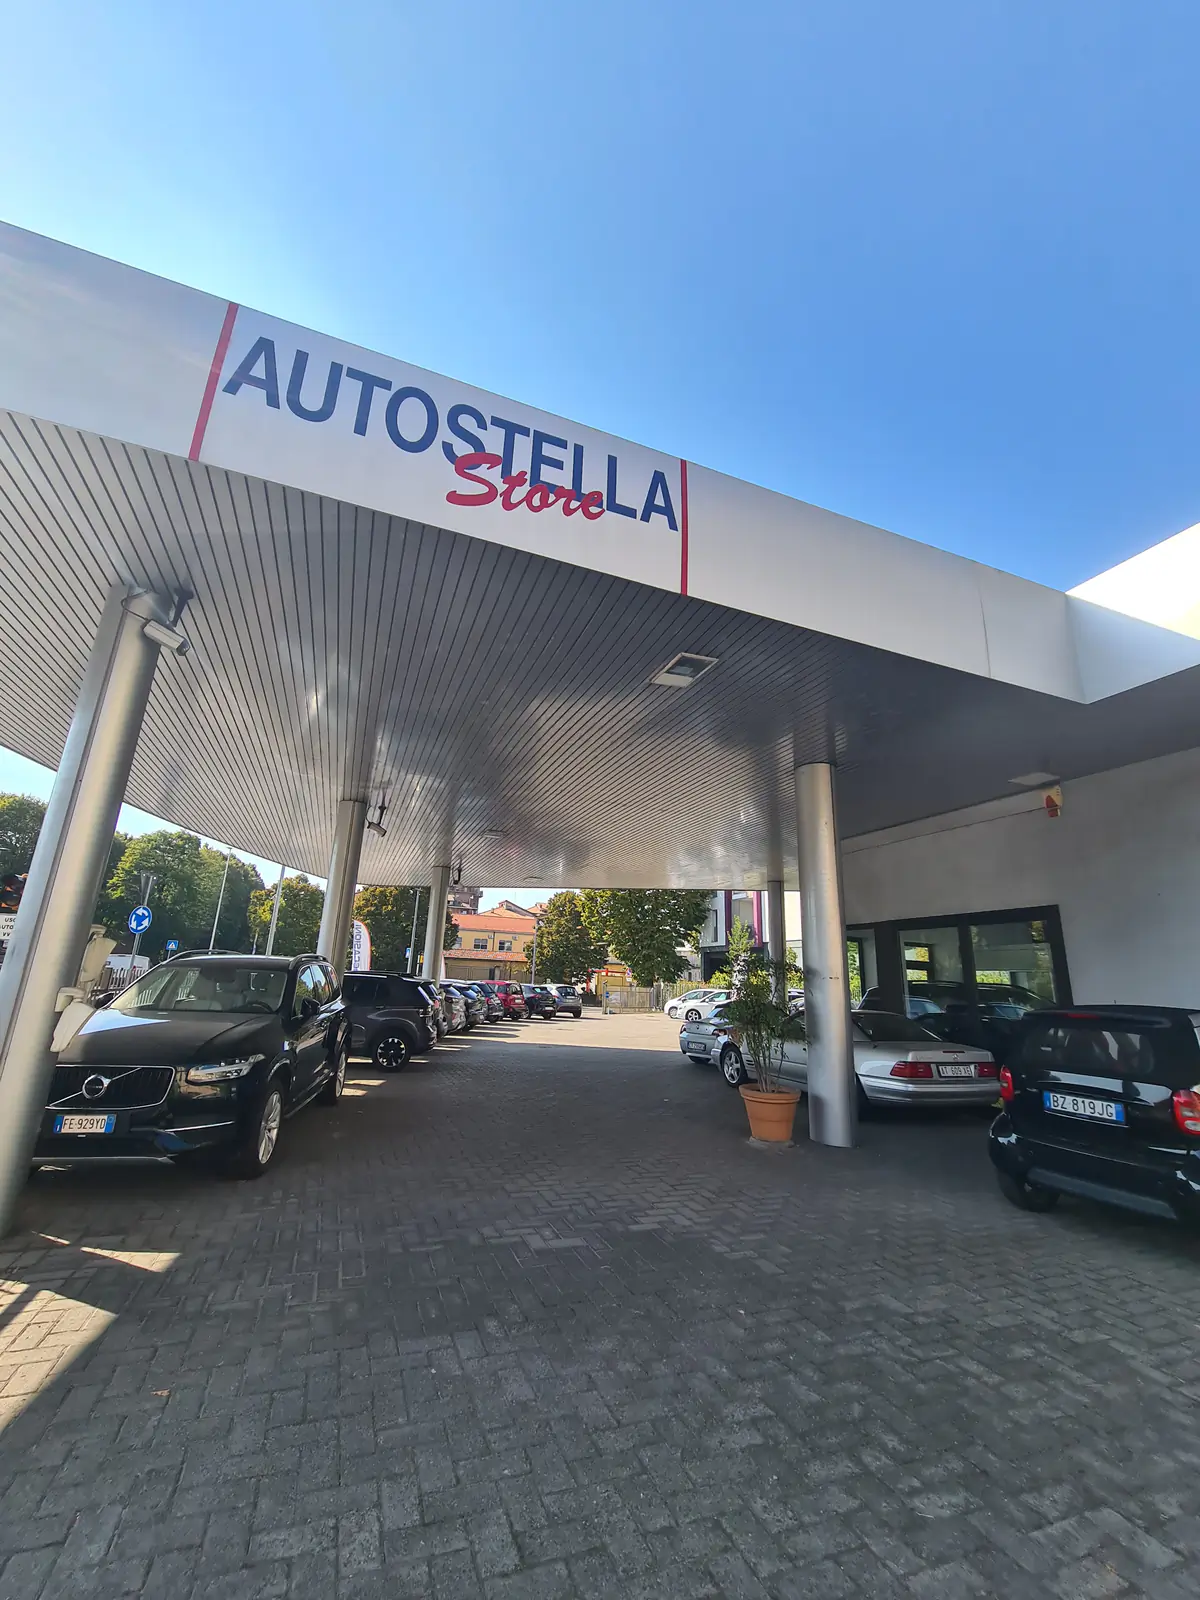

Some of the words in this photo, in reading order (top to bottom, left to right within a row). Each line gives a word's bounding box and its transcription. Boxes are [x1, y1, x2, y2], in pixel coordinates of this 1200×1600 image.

[222, 336, 679, 532] AUTOSTELLA
[446, 451, 606, 521] Store
[1052, 1094, 1067, 1110] BZ
[1071, 1098, 1114, 1118] 819JG
